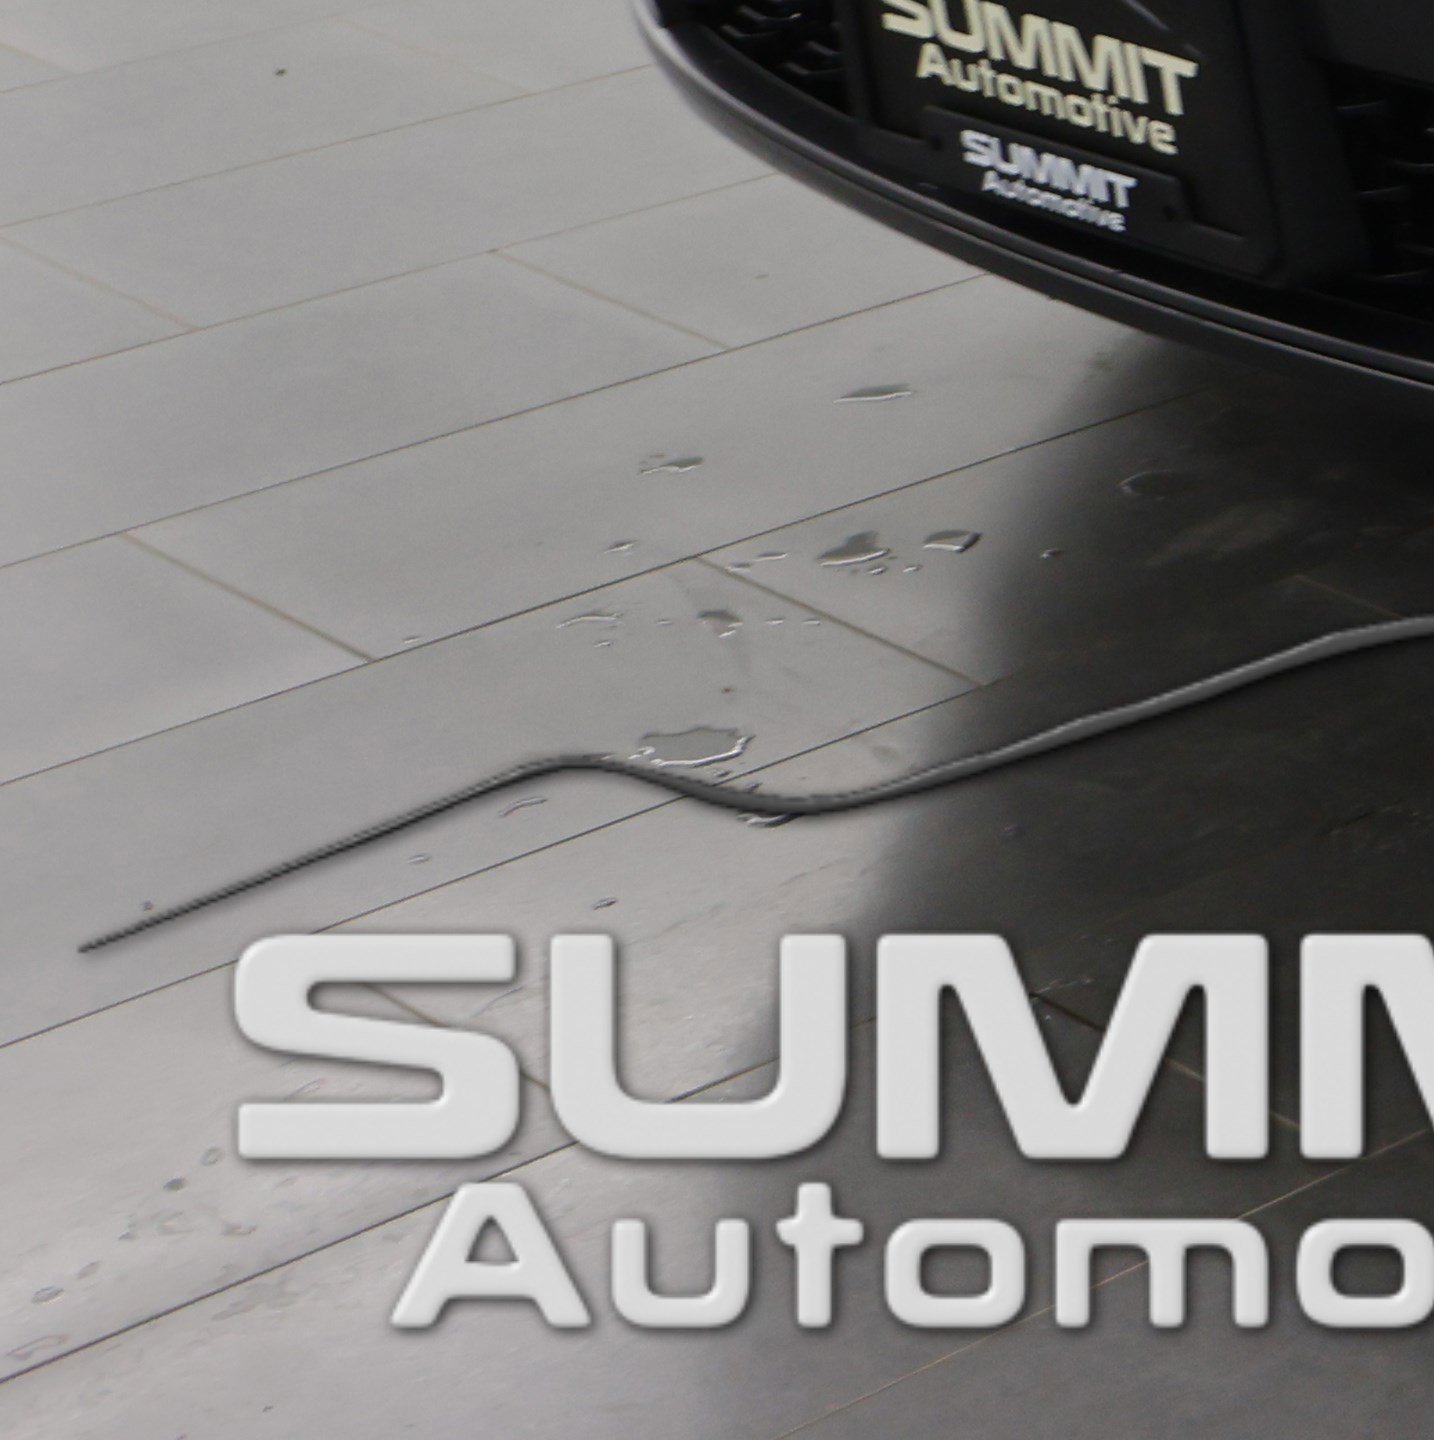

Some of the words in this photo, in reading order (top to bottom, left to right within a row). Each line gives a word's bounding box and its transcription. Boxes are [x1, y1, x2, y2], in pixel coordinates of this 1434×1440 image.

[917, 42, 1179, 156] Automotive
[959, 128, 1139, 209] SUMMIT
[982, 169, 1128, 233] Automotive
